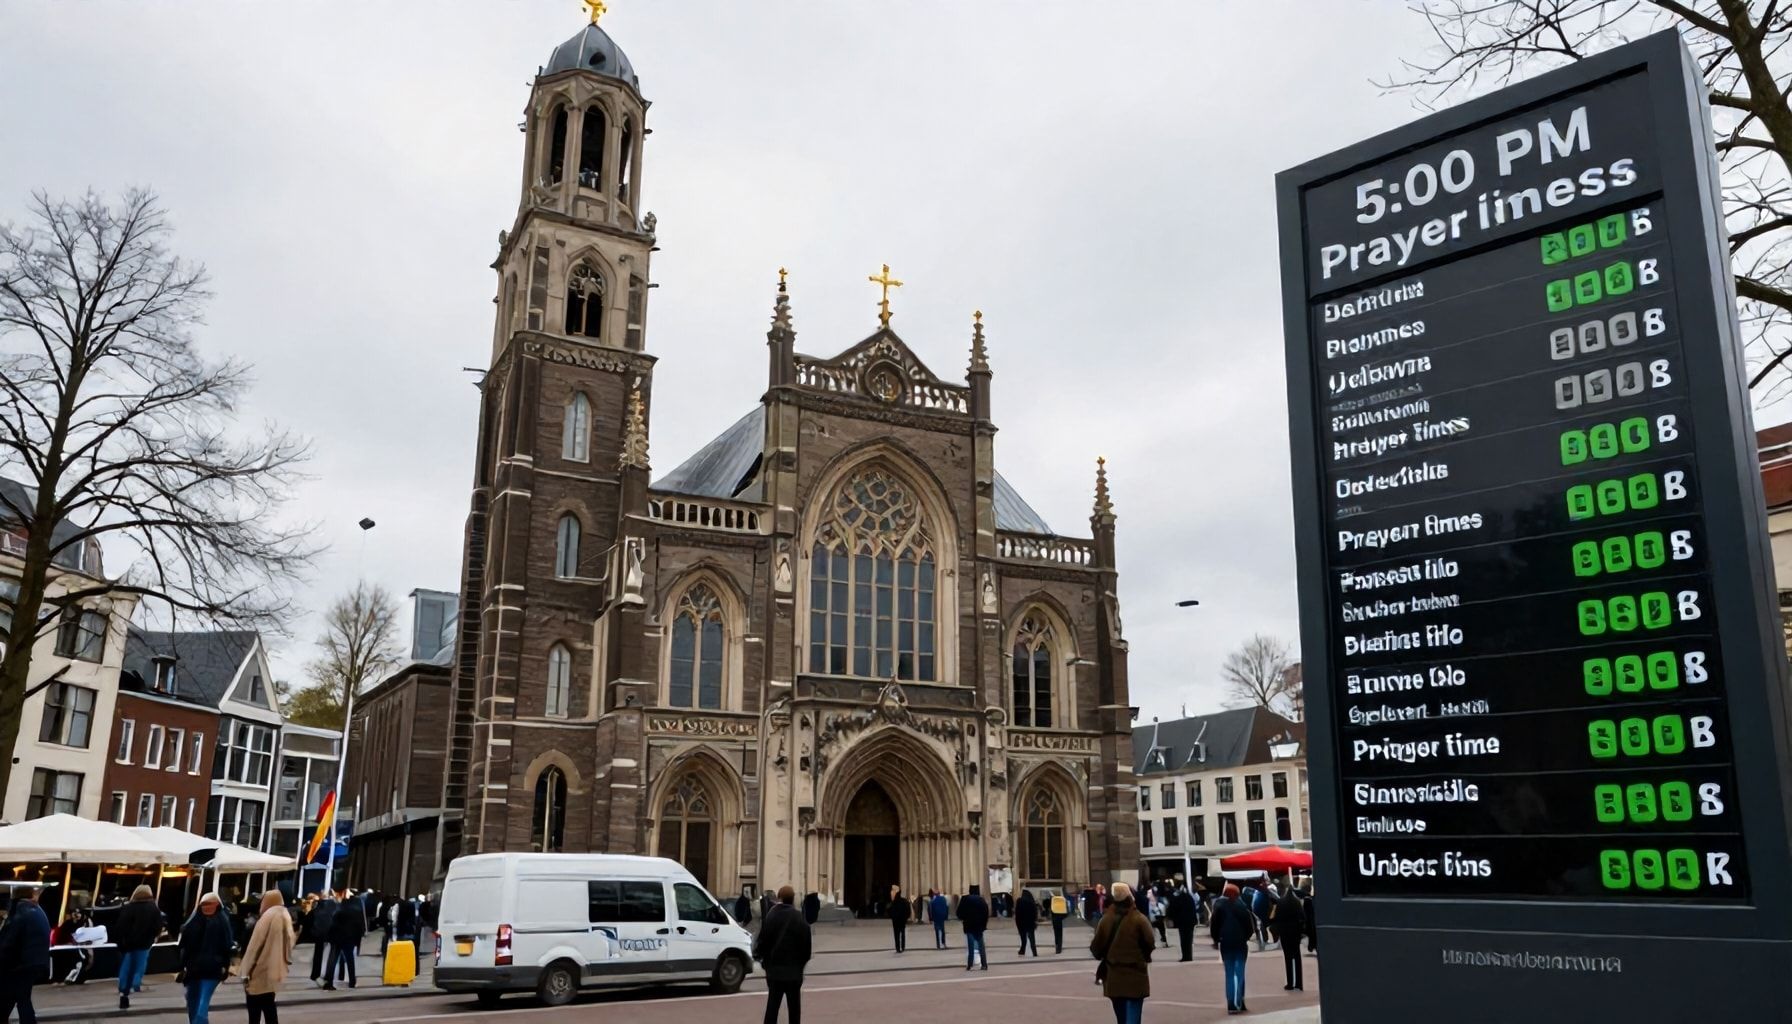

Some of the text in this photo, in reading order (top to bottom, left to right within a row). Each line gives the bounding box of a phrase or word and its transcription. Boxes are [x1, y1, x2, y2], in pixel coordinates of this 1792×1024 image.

[1355, 105, 1592, 225] 5:00 PM
[1320, 208, 1469, 280] Prayer
